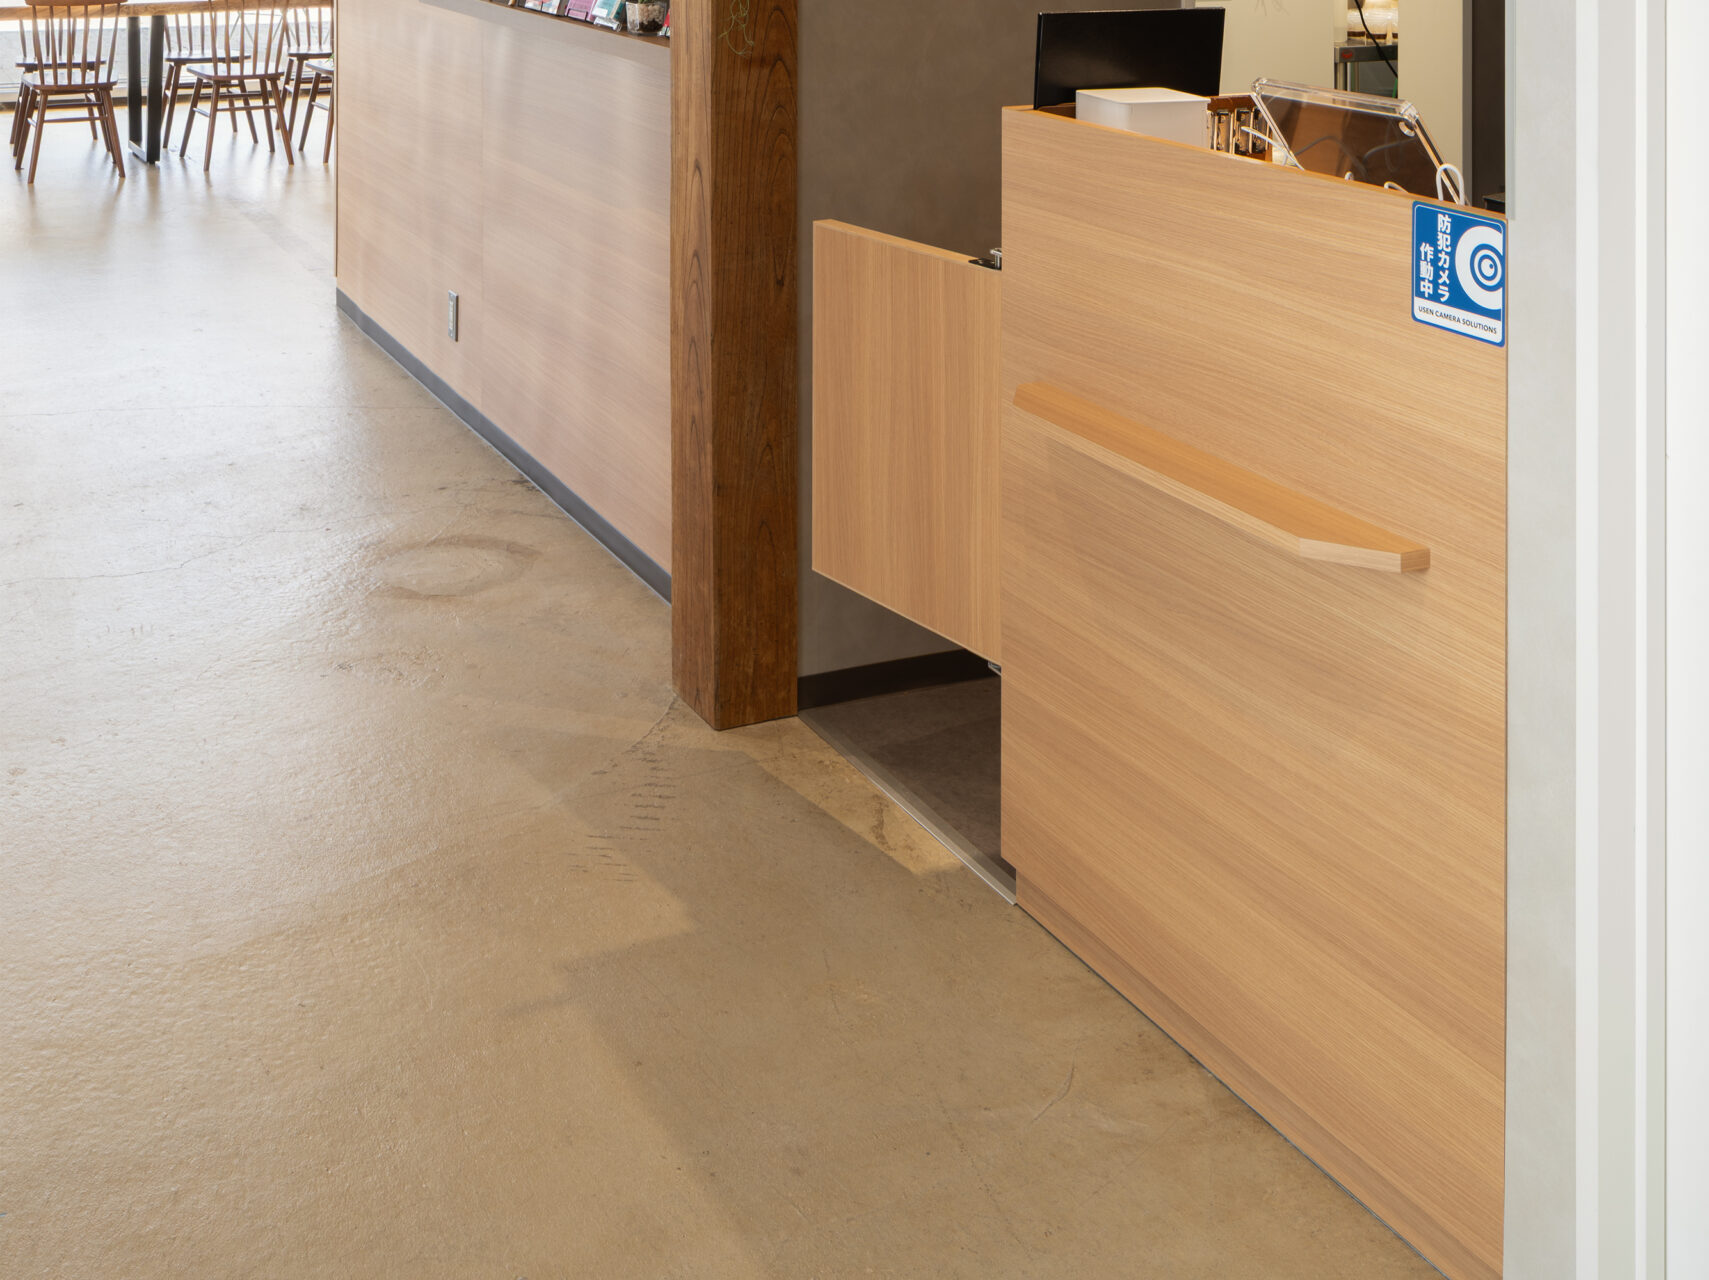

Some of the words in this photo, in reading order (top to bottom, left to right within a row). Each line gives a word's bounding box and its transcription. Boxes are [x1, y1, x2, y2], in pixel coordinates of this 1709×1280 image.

[1420, 242, 1434, 298] 作動中
[1437, 213, 1452, 303] 防犯カメラ
[1418, 305, 1434, 317] USEN
[1435, 310, 1461, 324] CAMERA
[1462, 318, 1498, 335] SOLUTIONS
